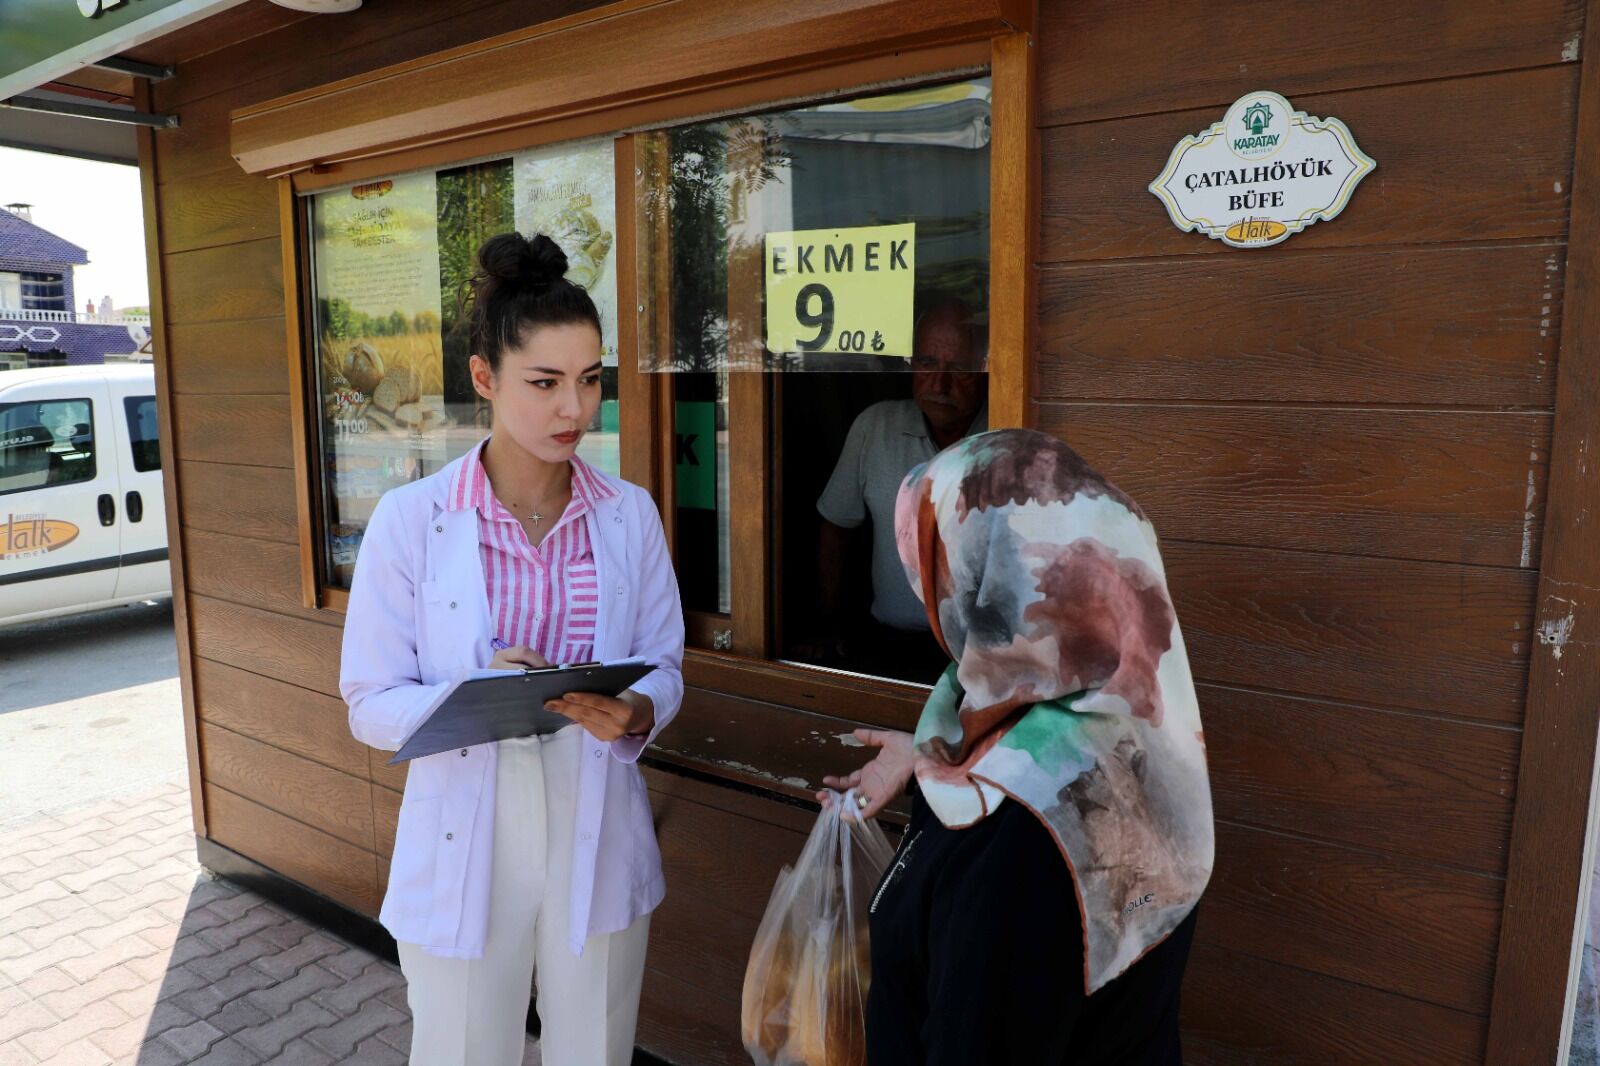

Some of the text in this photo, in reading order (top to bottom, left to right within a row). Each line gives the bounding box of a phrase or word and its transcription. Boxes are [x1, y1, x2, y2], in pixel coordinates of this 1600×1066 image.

[1233, 133, 1281, 151] KARATAY
[1185, 157, 1333, 193] ÇATALHÖYÜK
[1228, 189, 1284, 211] BÜFE
[1238, 215, 1272, 238] Halk
[772, 239, 909, 275] EKMEK
